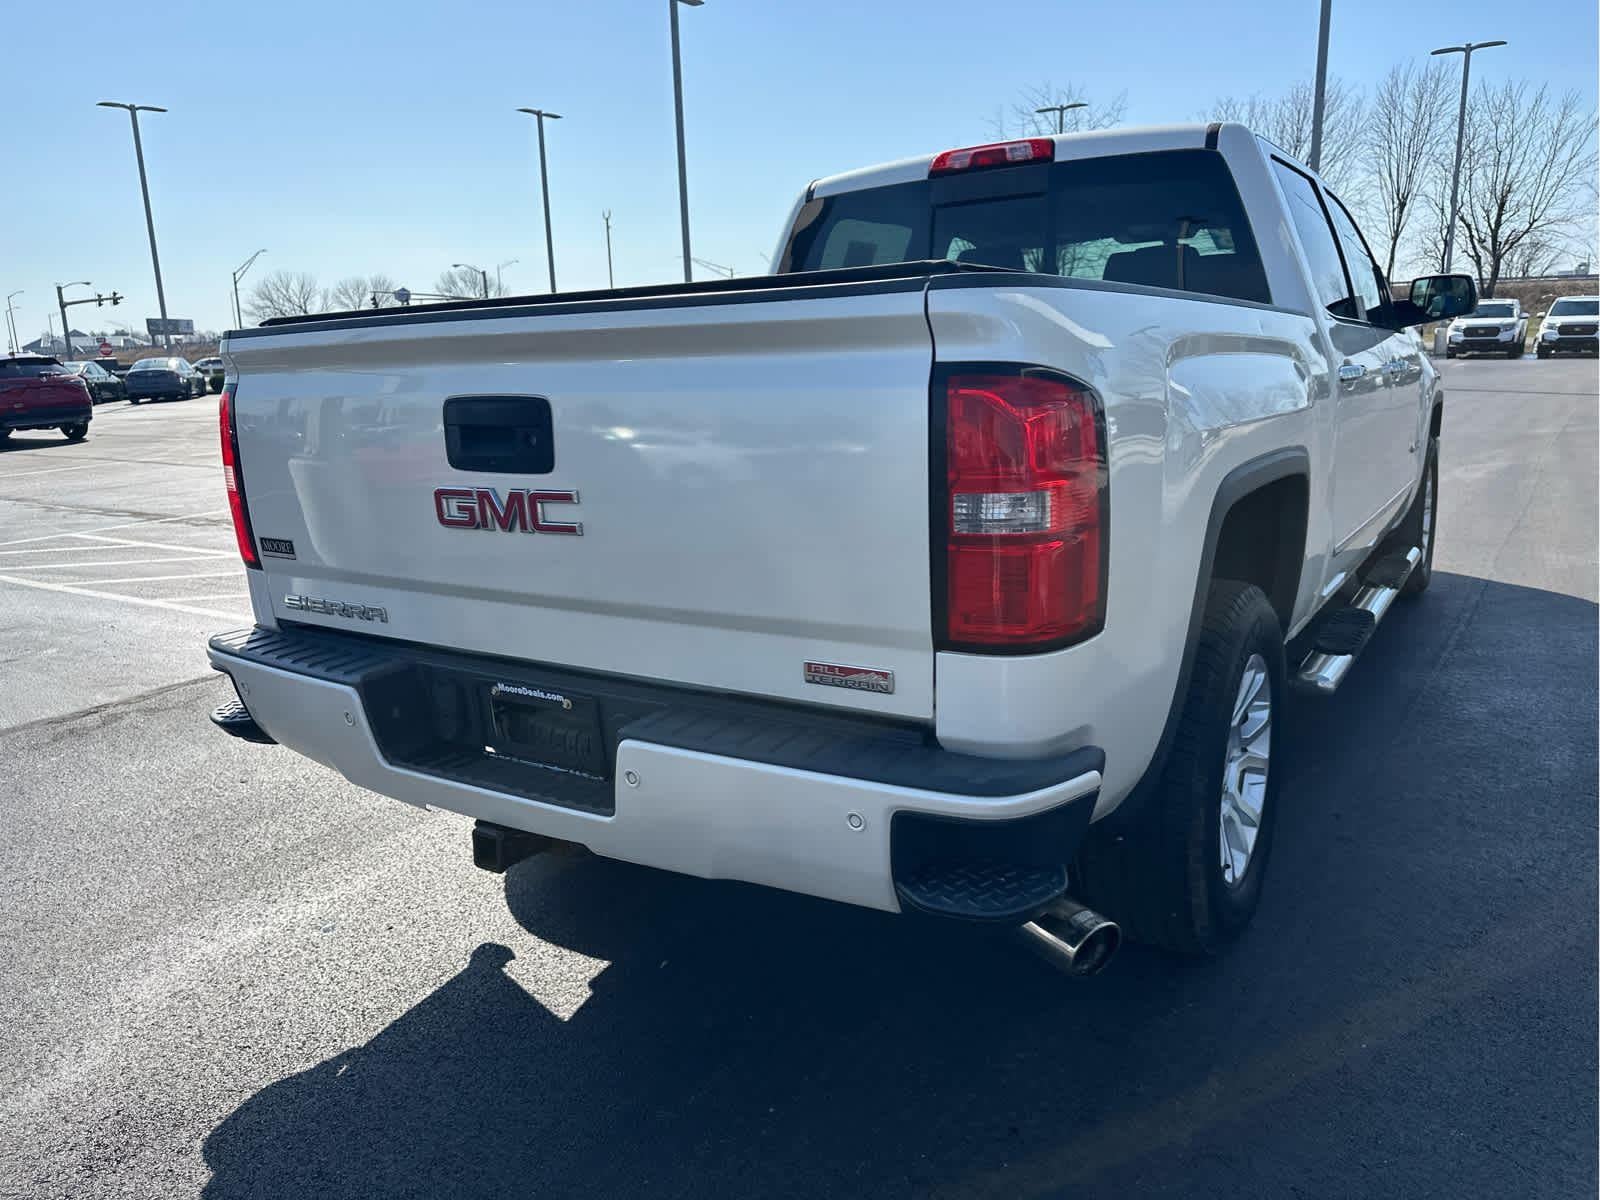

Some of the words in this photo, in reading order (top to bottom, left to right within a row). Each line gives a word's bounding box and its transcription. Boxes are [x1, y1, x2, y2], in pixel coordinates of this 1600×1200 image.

[434, 487, 584, 536] GMC
[262, 539, 293, 553] MOORE
[284, 594, 388, 623] SIERRA
[811, 664, 845, 676] ALL
[497, 682, 565, 703] MooreDeals.com
[807, 674, 889, 693] TERRAIN
